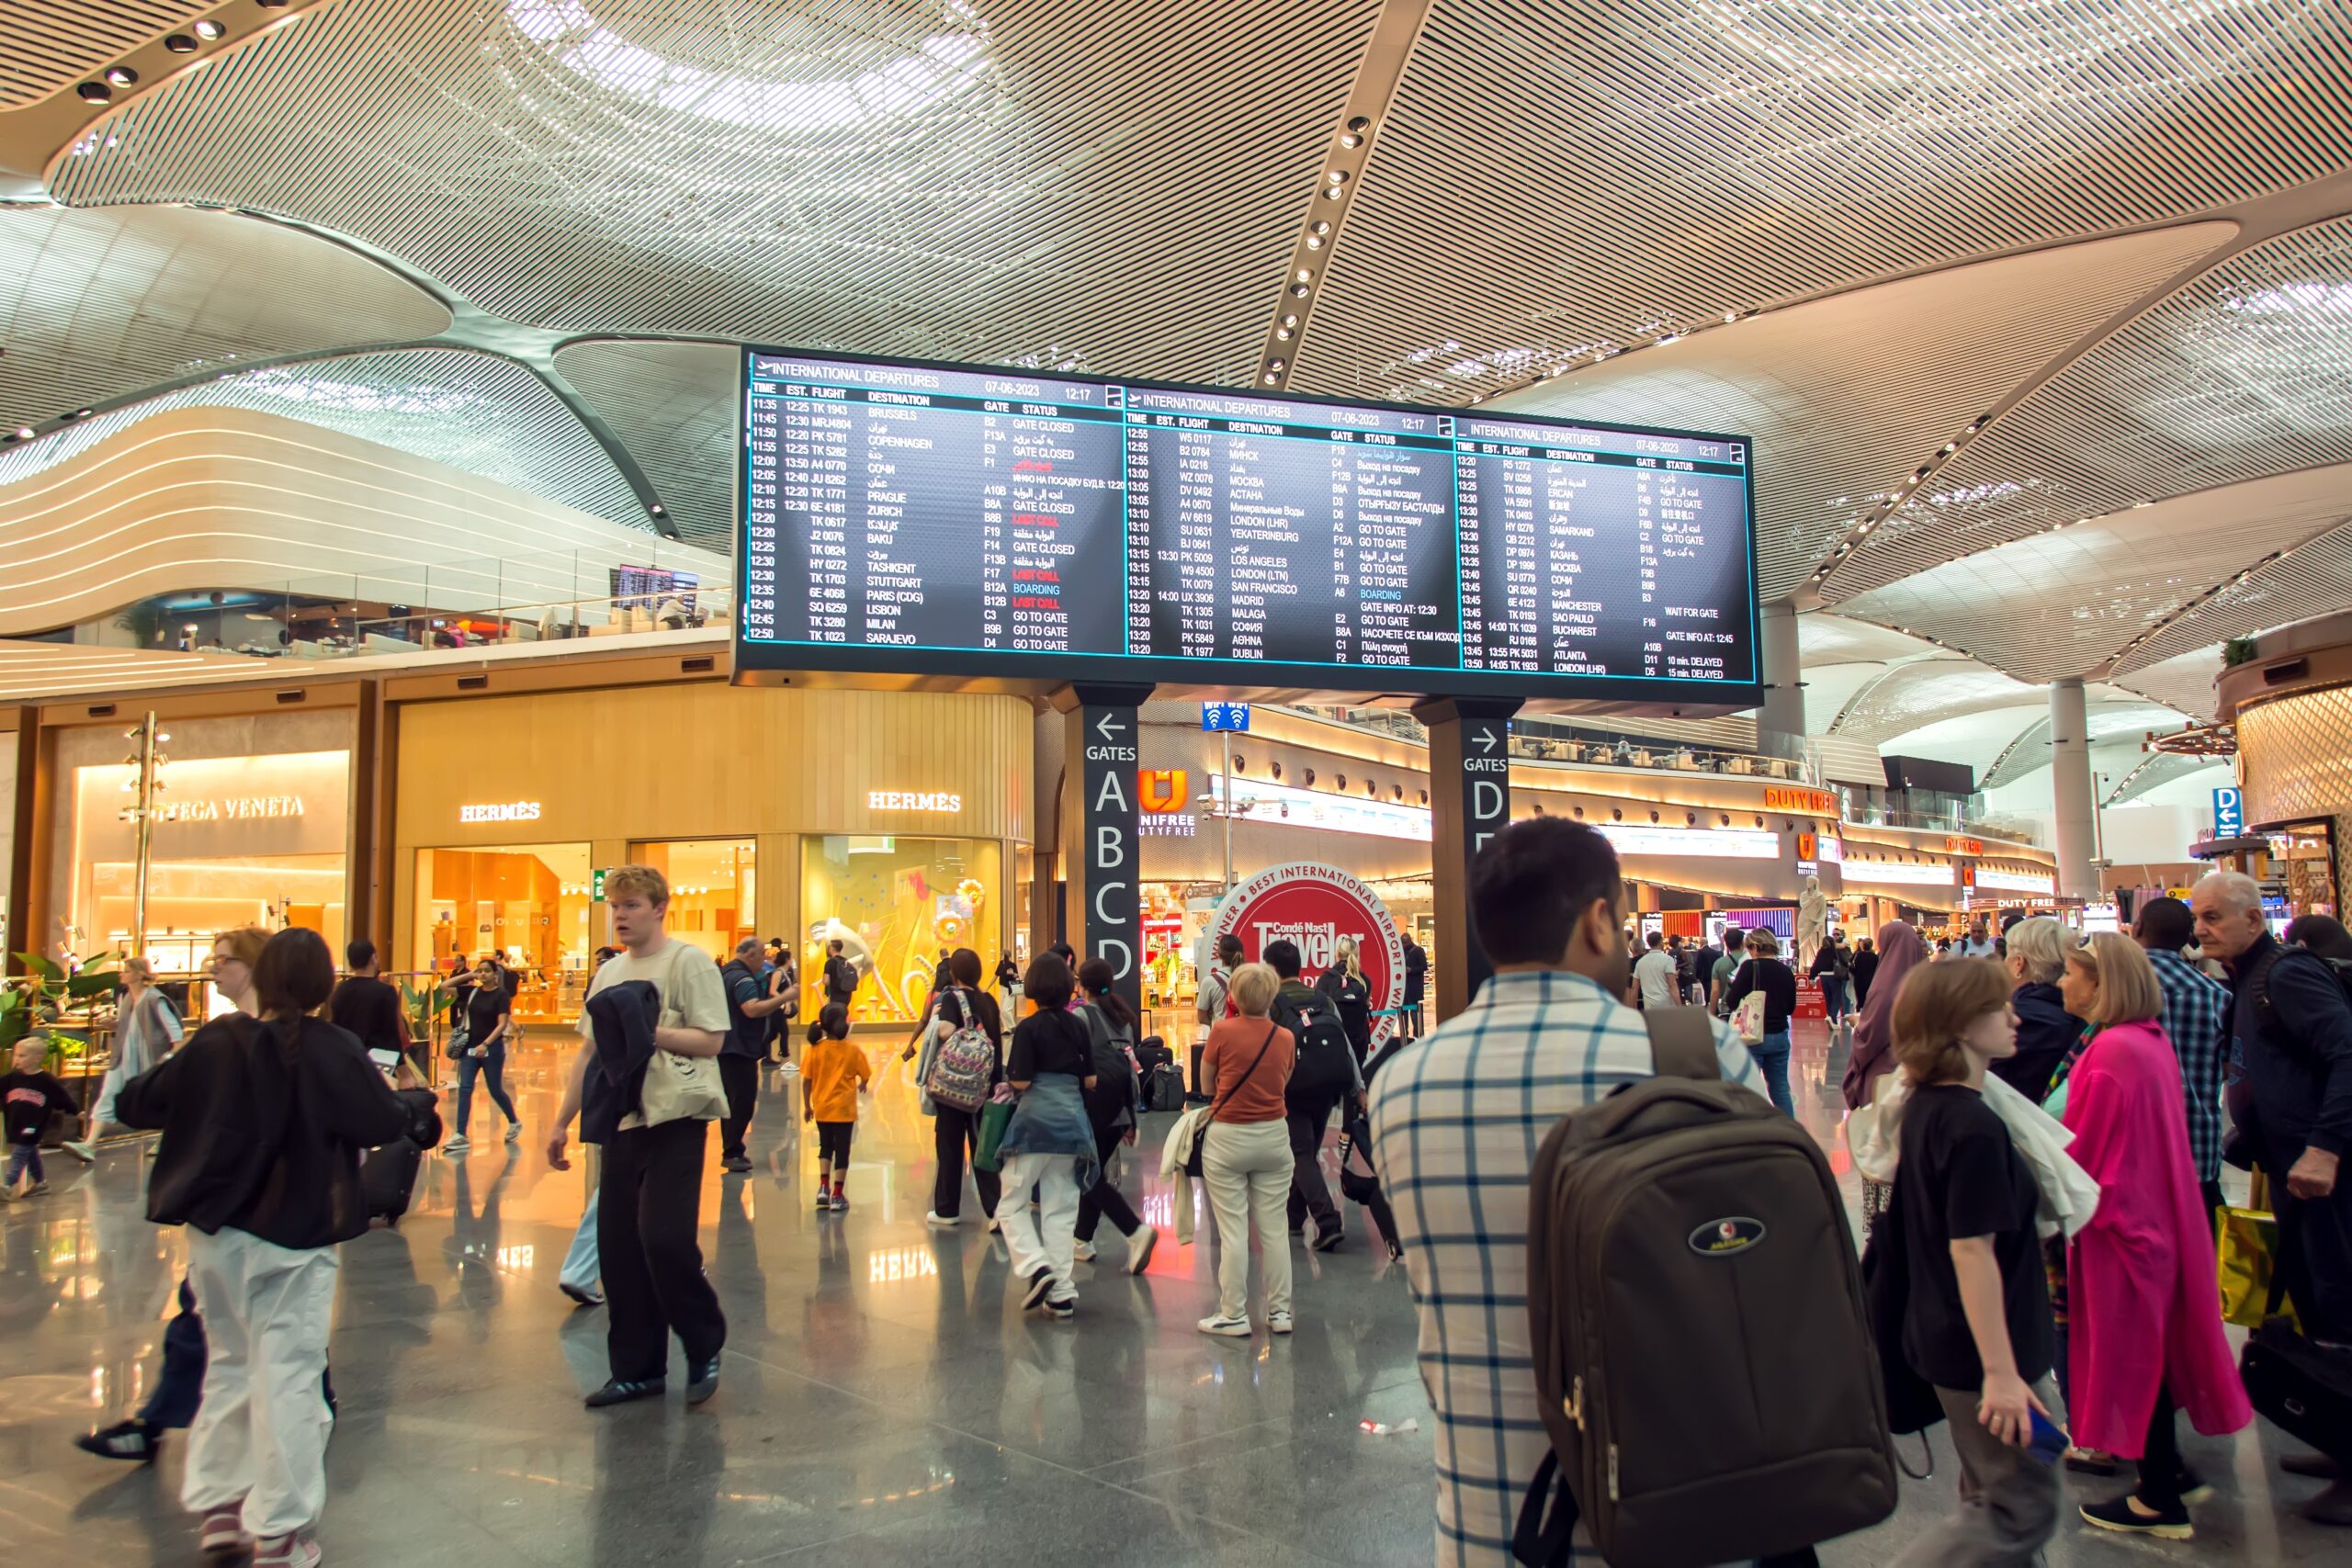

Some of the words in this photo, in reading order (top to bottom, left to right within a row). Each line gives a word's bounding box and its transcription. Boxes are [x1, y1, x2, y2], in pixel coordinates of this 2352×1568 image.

[771, 363, 861, 381] INTERNATIONAL
[865, 370, 938, 387] DEPARTURES
[753, 382, 775, 393] TIME
[787, 385, 807, 395] EST.
[812, 387, 845, 398] FLIGHT
[985, 380, 1039, 396] 07-06-2023
[869, 392, 928, 405] DESTINATION
[1065, 387, 1090, 400] 12:17
[753, 398, 776, 409] 11:35
[985, 401, 1008, 412] GATE
[1143, 394, 1222, 412] INTERNATIONAL
[1225, 402, 1289, 417] DEPARTURES
[868, 407, 916, 420] BRUSSELS
[1023, 404, 1057, 415] STATUS
[1127, 412, 1146, 423] TIME
[1157, 415, 1174, 426] EST.
[1179, 417, 1208, 428] FLIGHT
[1331, 411, 1379, 426] 07-06-2023
[1013, 419, 1036, 429] GATE
[1039, 421, 1074, 433] CLOSED
[1229, 422, 1281, 434] DESTINATION
[1402, 417, 1424, 430] 12:17
[752, 426, 776, 437] 11:50
[1127, 428, 1147, 438] 12:55
[1331, 431, 1352, 440] GATE
[1471, 425, 1540, 440] INTERNATIONAL
[1543, 431, 1600, 445] DEPARTURES
[868, 435, 932, 449] COPENHAGEN
[1365, 433, 1395, 444] STATUS
[1457, 441, 1474, 451] TIME
[1483, 444, 1499, 453] EST.
[1503, 446, 1528, 456] FLIGHT
[1636, 439, 1678, 453] 07-06-2023
[1698, 445, 1718, 456] 12:17
[1013, 446, 1036, 456] GATE
[1039, 448, 1074, 460] CLOSED
[1547, 450, 1593, 461] DESTINATION
[1457, 456, 1475, 465] 13:20
[1637, 458, 1655, 467] GATE
[1666, 461, 1692, 470] STATUS
[1127, 468, 1148, 478] 13:00
[1457, 468, 1476, 478] 13:25
[751, 483, 775, 494] 12:10
[1548, 488, 1573, 498] ERCAN
[868, 491, 906, 503] PRAGUE
[867, 504, 902, 517] ZURICH
[1013, 500, 1037, 511] GATE
[1039, 502, 1074, 514] CLOSED
[1458, 506, 1477, 516] 13:30
[1127, 508, 1148, 518] 13:10
[1230, 515, 1264, 526] LONDON
[1267, 517, 1287, 529] (LHR)
[750, 526, 775, 537] 12:20
[1230, 528, 1298, 542] YEKATERINBURG
[1549, 525, 1593, 536] SAMARKAND
[867, 533, 892, 544] BAKU
[1013, 541, 1037, 552] GATE
[1039, 543, 1074, 554] CLOSED
[1231, 555, 1247, 565] LOS
[1249, 556, 1287, 567] ANGELES
[867, 561, 916, 573] TASHKENT
[1128, 562, 1149, 572] 13:15
[749, 570, 774, 580] 12:30
[1231, 568, 1265, 579] LONDON
[1268, 570, 1288, 582] (LTN)
[867, 575, 922, 588] STUTTGART
[1014, 583, 1059, 594] BOARDING
[1231, 581, 1248, 591] SAN
[1250, 582, 1297, 594] FRANCISCO
[867, 590, 894, 600] PARIS
[897, 591, 923, 604] (CDG)
[1232, 594, 1263, 605] MADRID
[1360, 589, 1401, 600] BOARDING
[749, 599, 774, 609] 12:40
[866, 604, 900, 615] LISBON
[1361, 602, 1381, 611] GATE
[1384, 603, 1402, 613] INFO
[1403, 604, 1415, 613] AT:
[1417, 605, 1436, 615] 12:30
[1552, 600, 1601, 611] MANCHESTER
[1232, 608, 1266, 619] MALAGA
[1552, 612, 1567, 622] SAO
[1569, 613, 1593, 623] PAULO
[1664, 607, 1682, 615] WAIT
[1683, 608, 1698, 616] FOR
[1699, 608, 1718, 618] GATE
[866, 618, 895, 629] MILAN
[1128, 616, 1149, 626] 13:20
[748, 628, 773, 638] 12:50
[1553, 625, 1597, 636] BUCHAREST
[866, 633, 915, 644] SARAJEVO
[1666, 631, 1684, 640] GATE
[1686, 632, 1702, 641] INFO
[1703, 633, 1714, 642] AT:
[1716, 634, 1733, 643] 12:45
[1013, 639, 1027, 649] GO
[1029, 639, 1041, 649] TO
[1044, 640, 1067, 650] GATE
[1233, 648, 1262, 658] DUBLIN
[1553, 650, 1586, 660] ATLANTA
[1463, 659, 1482, 668] 13:50
[1667, 656, 1675, 664] 10
[1691, 657, 1722, 666] DELAYED
[1554, 663, 1584, 672] LONDON
[1586, 664, 1605, 674] (LHR)
[1691, 669, 1722, 678] DELAYED
[1086, 745, 1136, 761] GATES
[1464, 758, 1507, 772] GATES
[1096, 771, 1128, 812] A
[868, 791, 961, 812] HERMÈS
[1474, 781, 1503, 820] D
[1765, 788, 1808, 811] DUTY
[2218, 789, 2237, 808] D
[128, 800, 219, 823] TEGA
[224, 796, 304, 818] VENETA
[460, 801, 541, 823] HERMÈS
[1140, 814, 1195, 826] NIFREE
[1138, 826, 1195, 836] UTYFREE
[1098, 826, 1124, 868] B
[1096, 882, 1127, 925] C
[1998, 898, 2028, 908] DUTY
[2031, 898, 2055, 907] FREE
[1248, 872, 1276, 896] BEST
[1280, 865, 1377, 910] INTERNATIONAL
[1376, 911, 1402, 966] AIRPORT
[1273, 922, 1304, 933] Condé
[1305, 922, 1328, 933] Nast
[1253, 922, 1364, 969] Tvel
[1098, 939, 1131, 981] D
